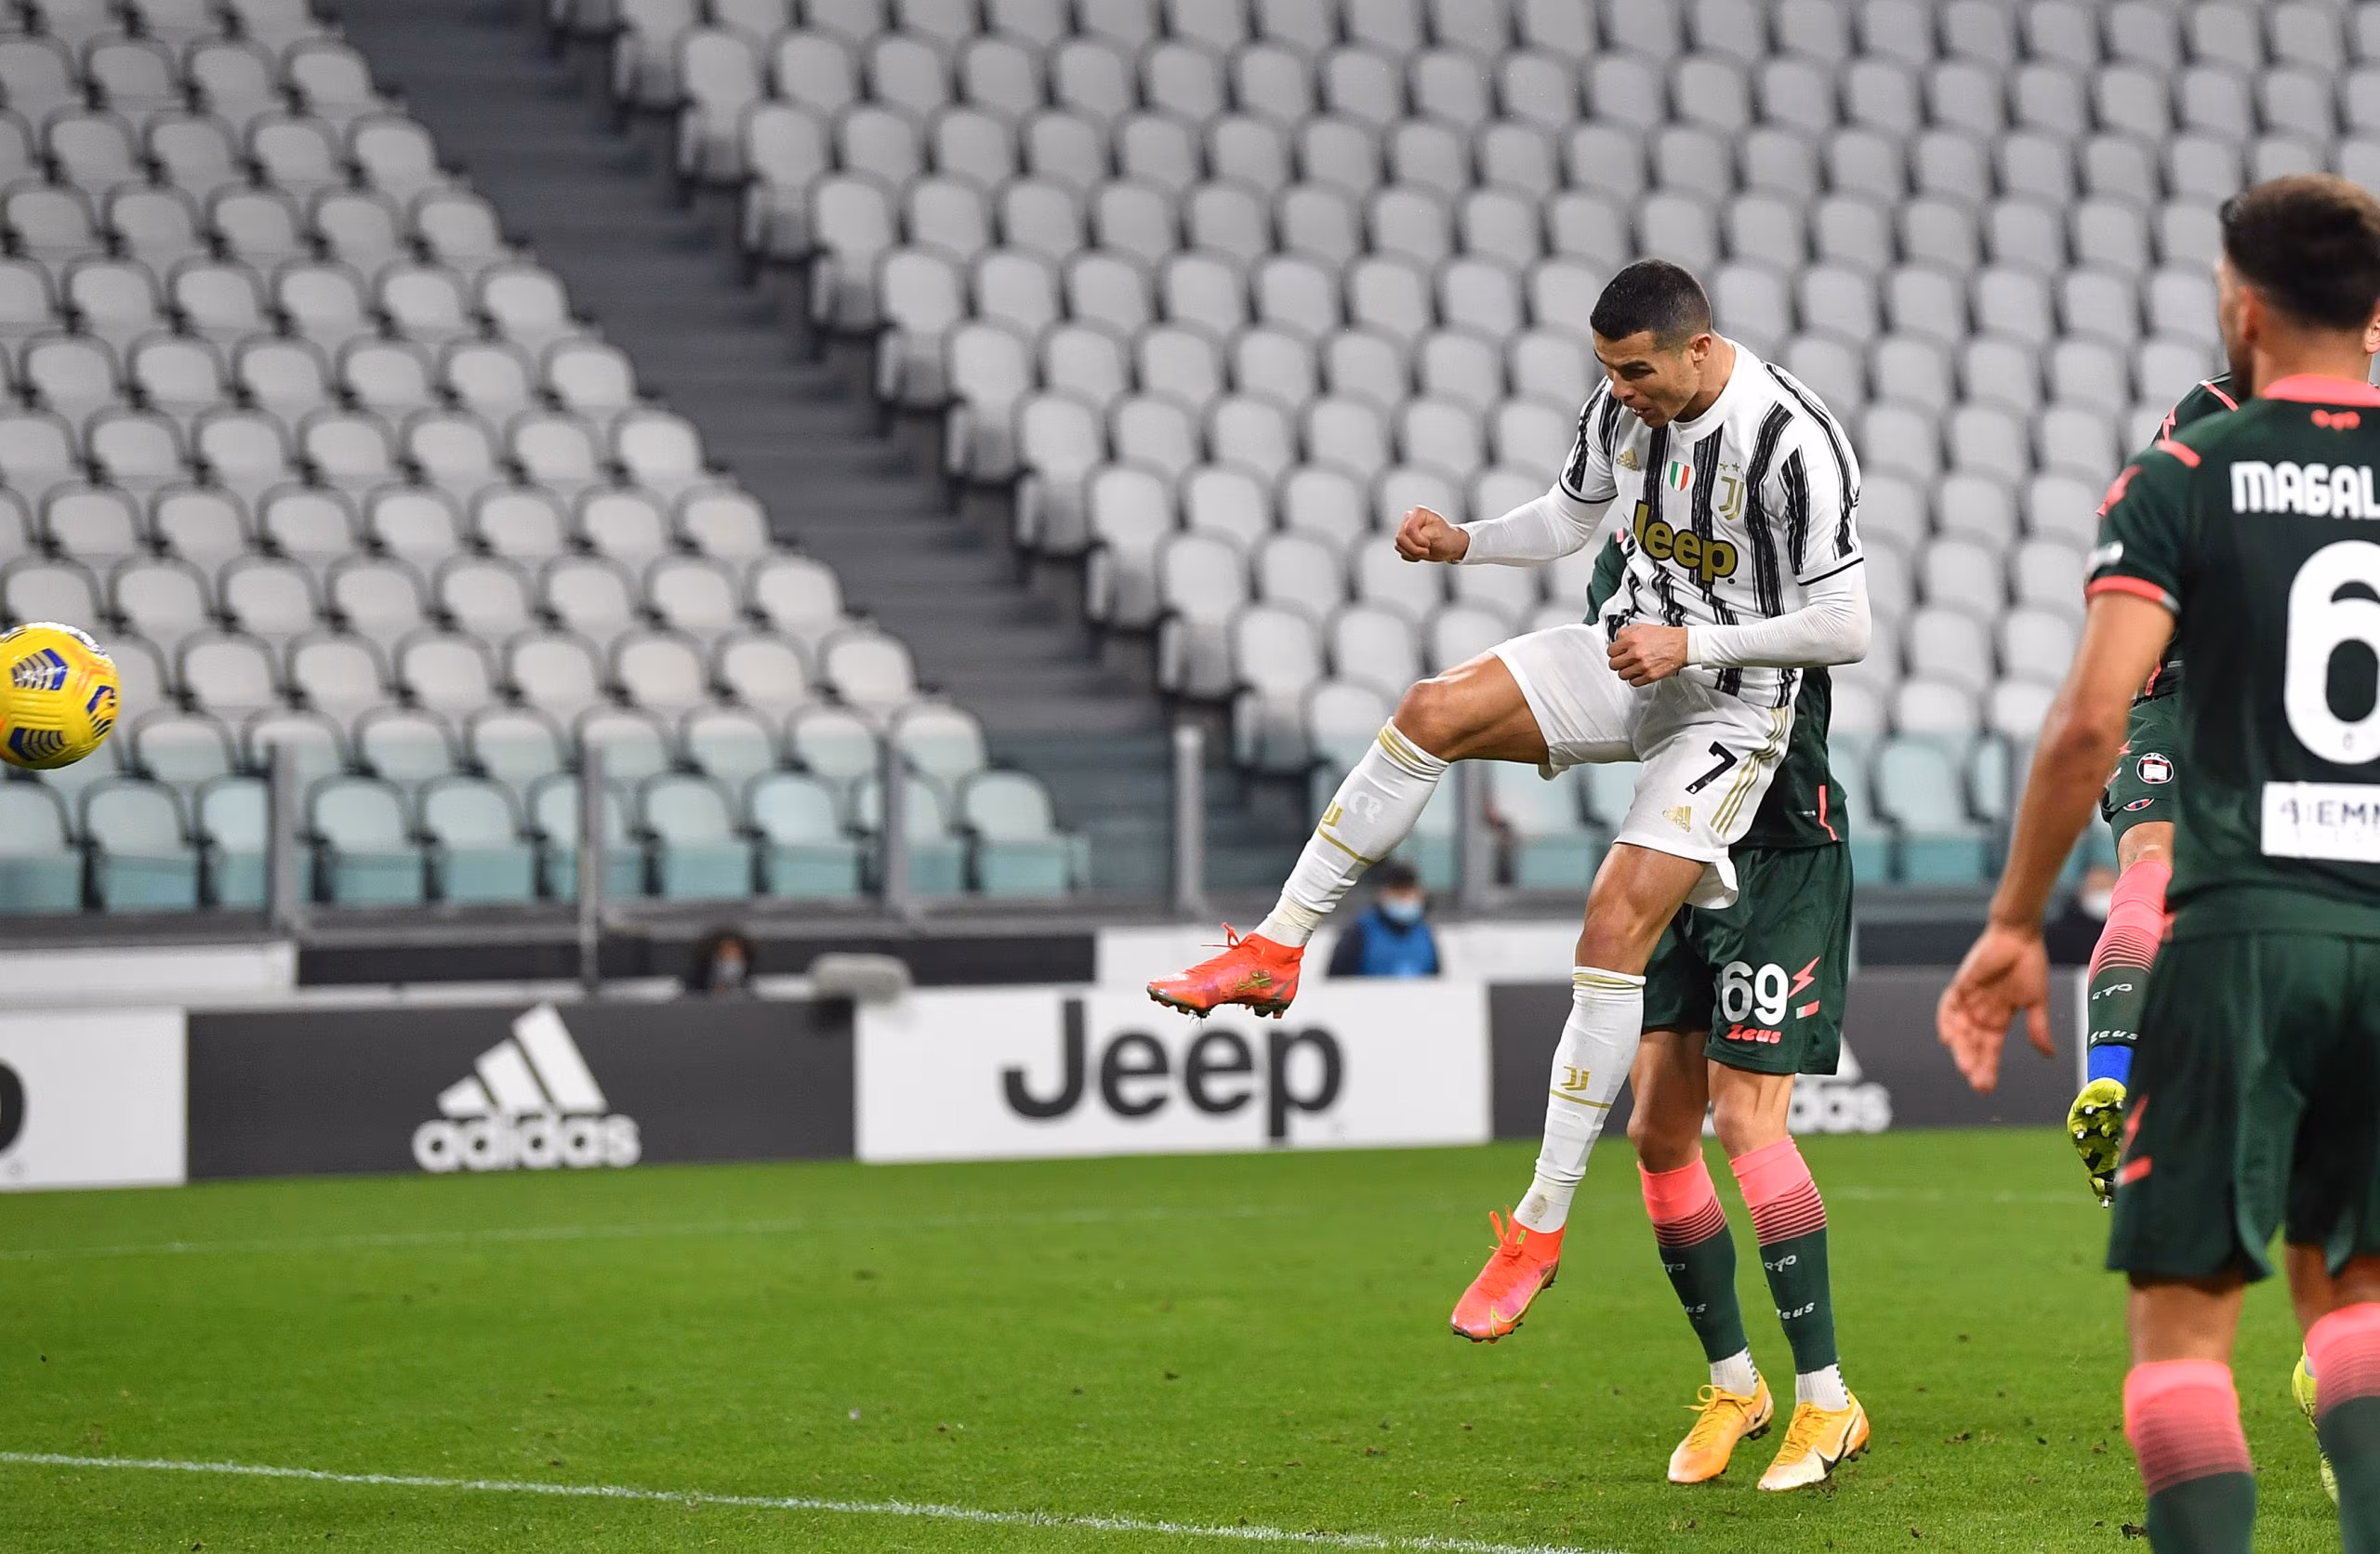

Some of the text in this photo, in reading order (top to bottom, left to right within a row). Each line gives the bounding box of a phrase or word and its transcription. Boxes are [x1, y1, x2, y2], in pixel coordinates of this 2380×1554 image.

[2229, 460, 2380, 520] MAGAL
[1632, 500, 1738, 584] Jeep
[2283, 538, 2380, 766] 6
[1685, 741, 1738, 795] 7
[1722, 961, 1789, 1025] 69
[1726, 1024, 1782, 1044] Zeus
[1001, 998, 1342, 1144] Jeep
[412, 1107, 642, 1173] adidas
